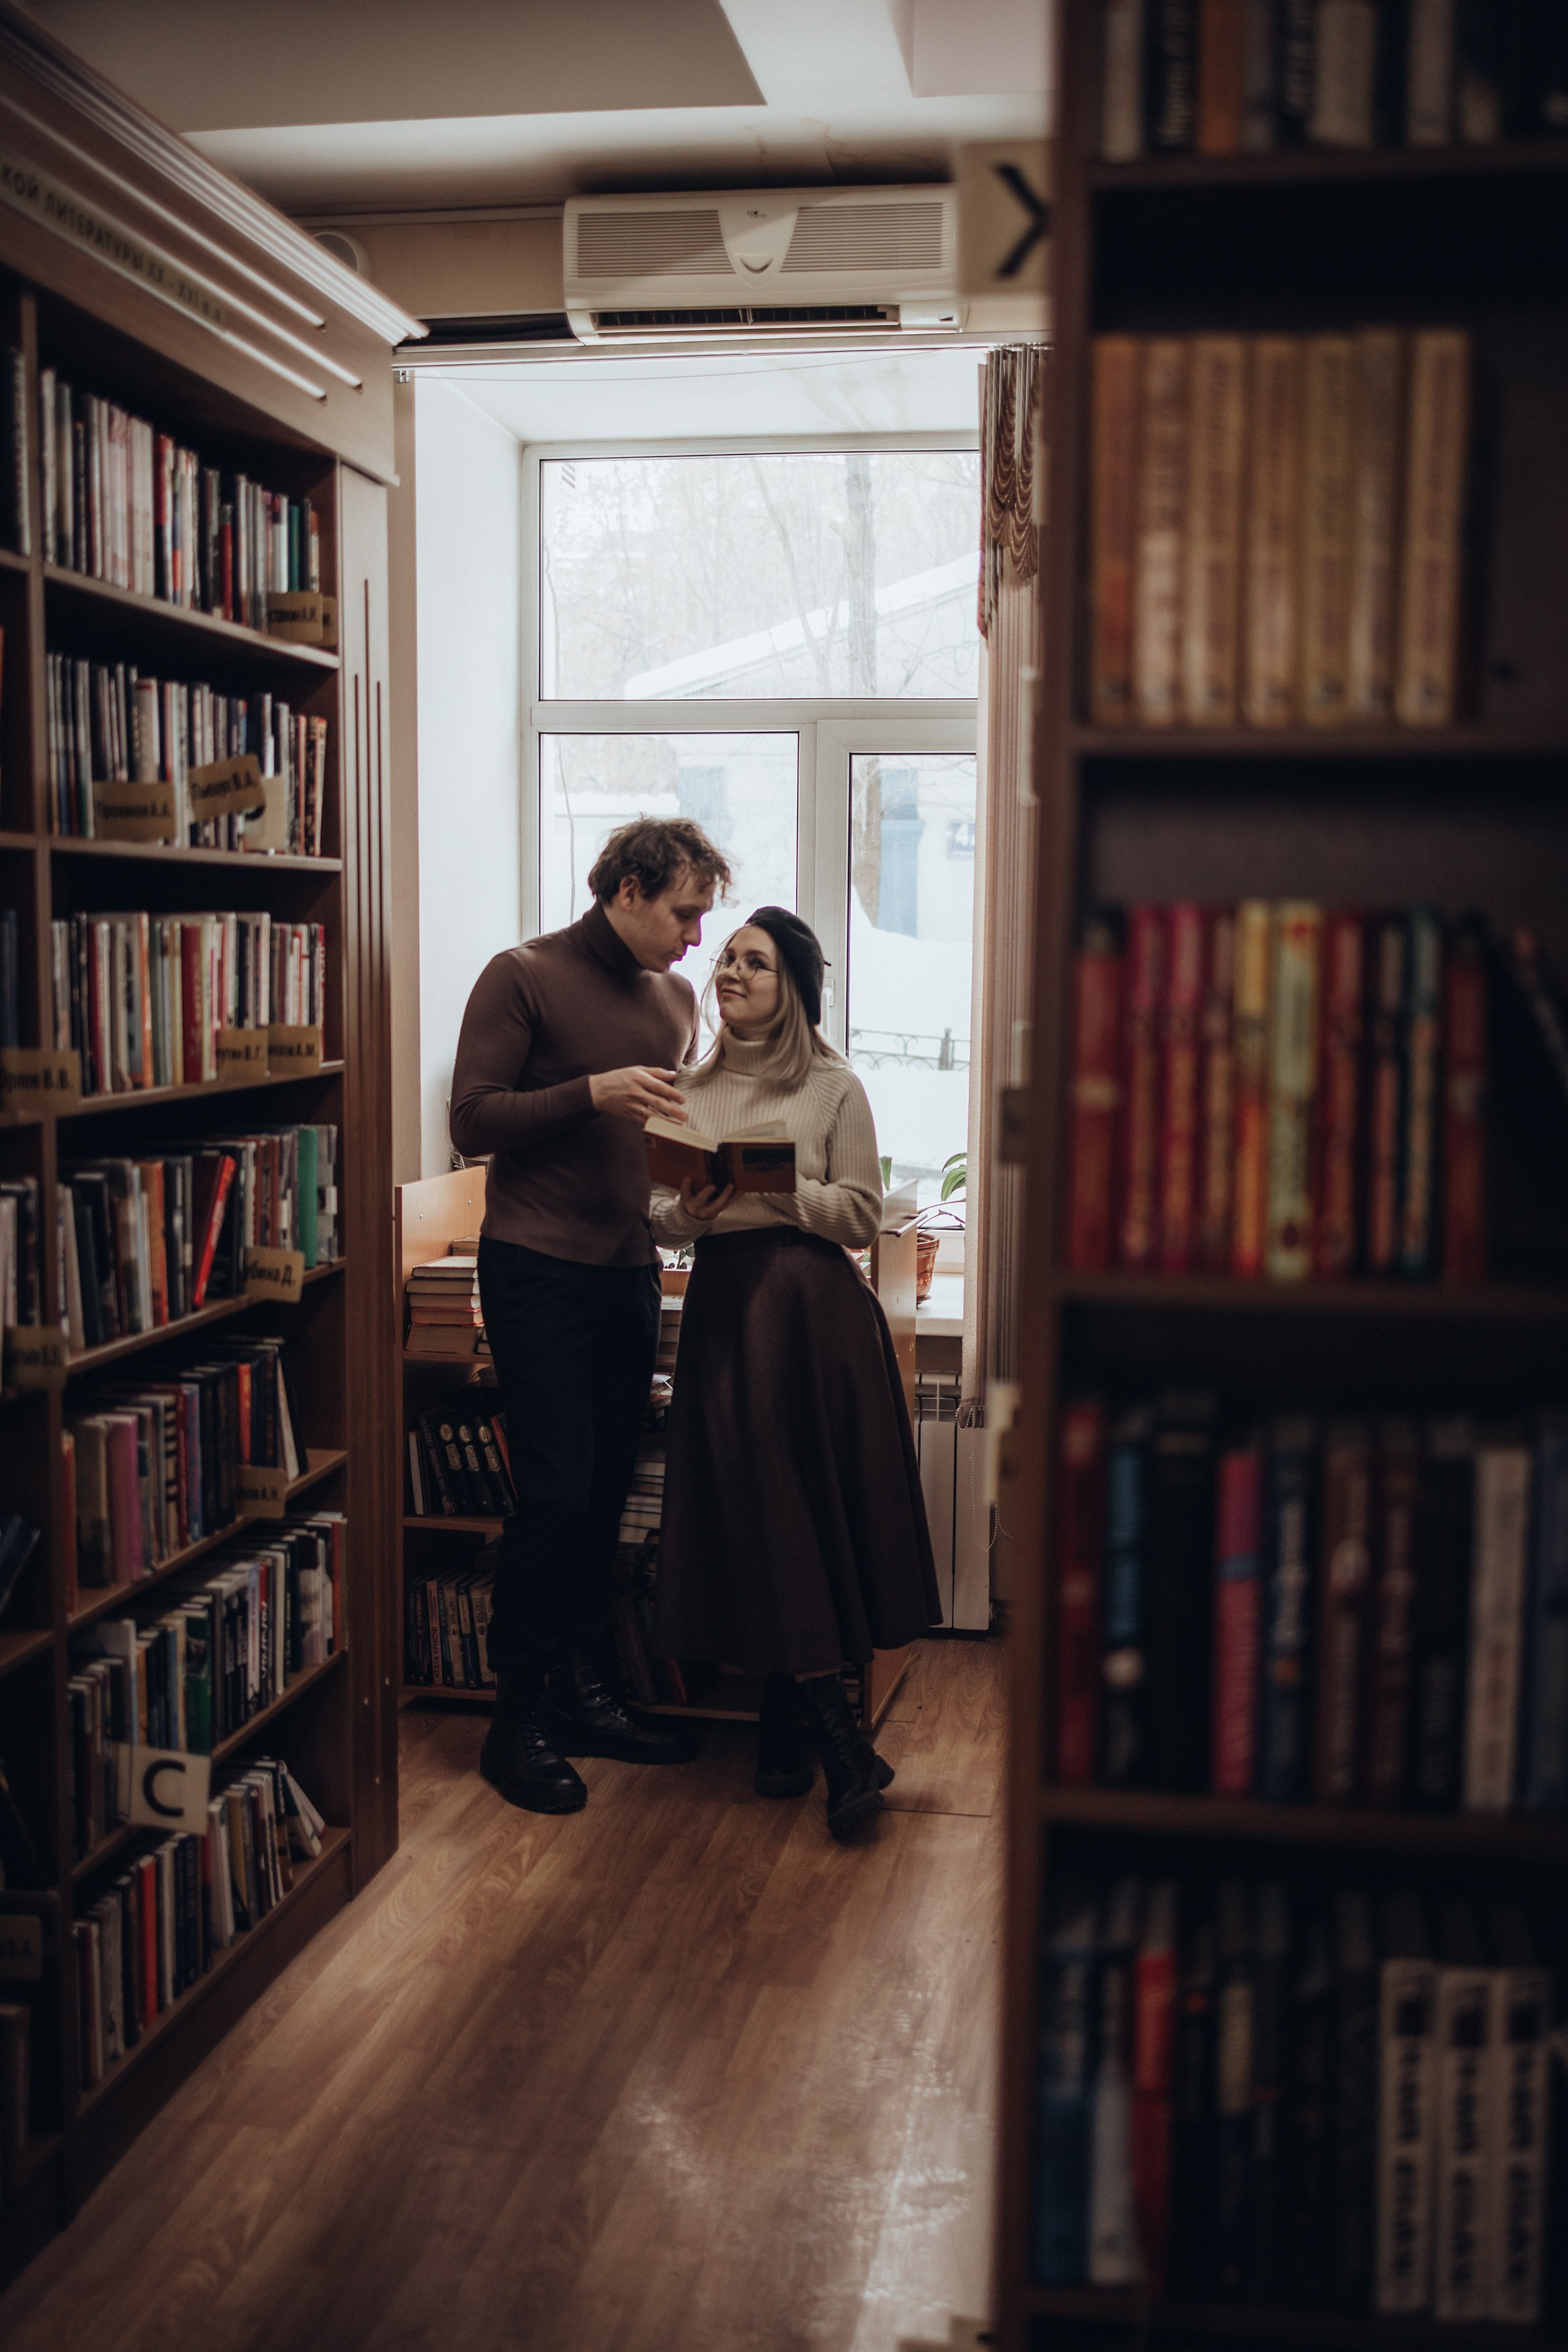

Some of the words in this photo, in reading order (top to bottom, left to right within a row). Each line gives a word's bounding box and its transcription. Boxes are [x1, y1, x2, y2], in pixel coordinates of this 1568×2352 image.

[44, 192, 144, 271] ЛИТЕРАТУРЫ
[431, 1626, 440, 1654] КРИСТИ
[433, 1655, 441, 1679] АГАТА
